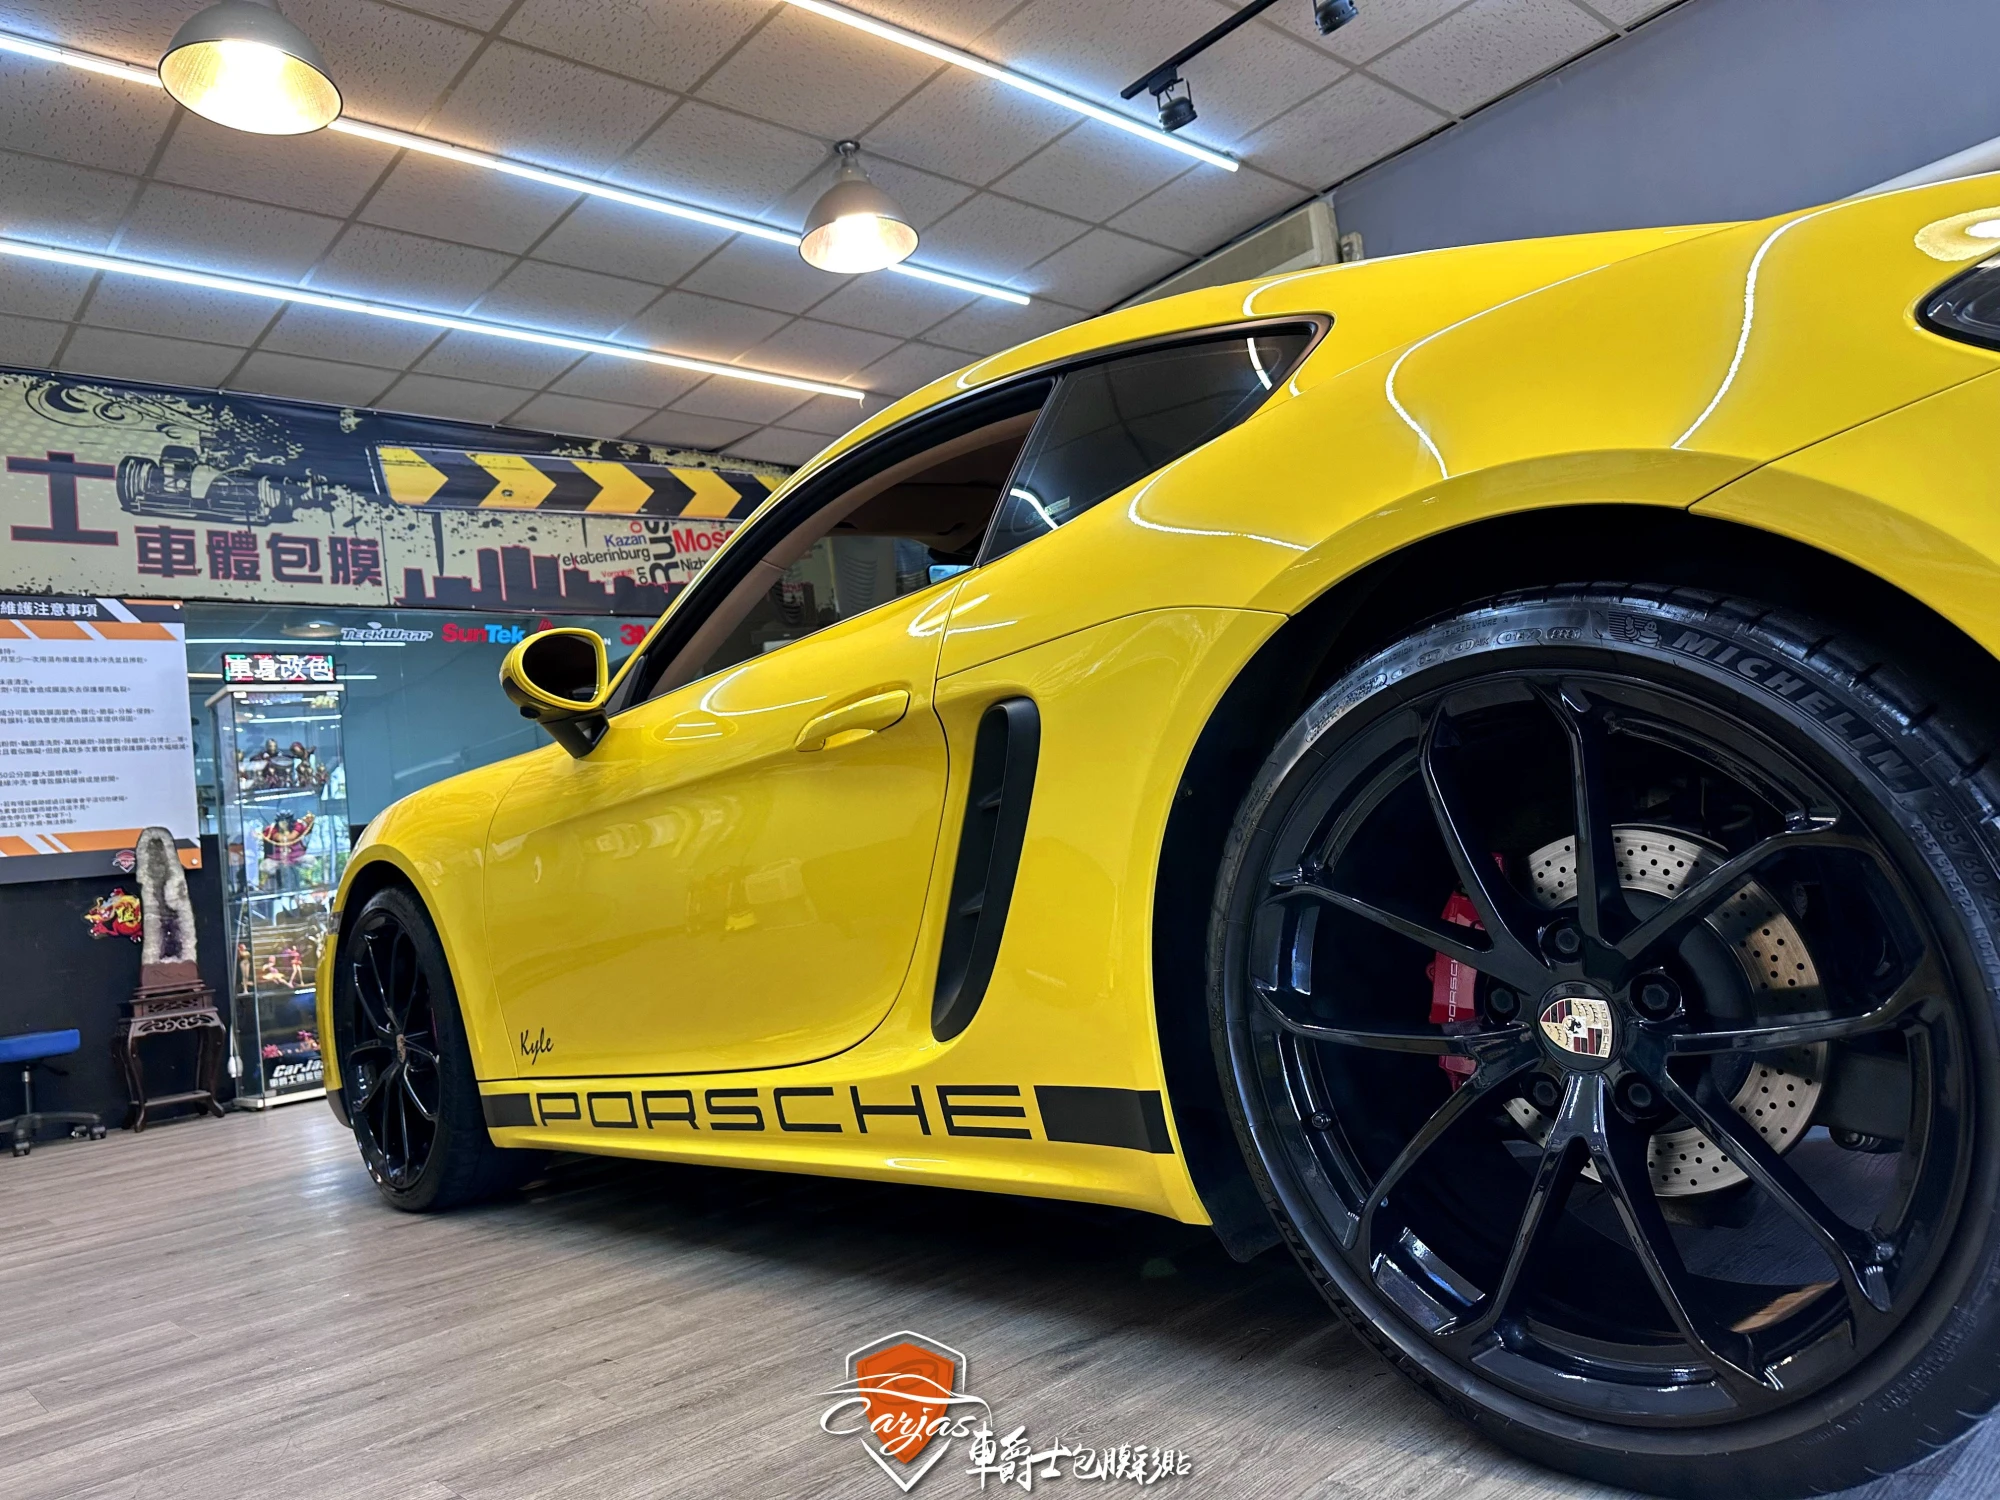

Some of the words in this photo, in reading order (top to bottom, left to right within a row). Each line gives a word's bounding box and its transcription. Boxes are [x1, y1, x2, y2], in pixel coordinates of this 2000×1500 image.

[6, 450, 119, 546] 士
[134, 524, 384, 587] 車體包膜
[603, 533, 648, 548] Kazan
[442, 623, 526, 644] SunTek
[229, 657, 330, 681] 車身改色
[1671, 631, 1926, 797] MICHELIN
[1928, 808, 1990, 885] 295/30
[520, 1027, 555, 1066] Kyle
[1600, 1004, 1611, 1056] PORSCHE
[537, 1085, 1033, 1140] PORSCHE
